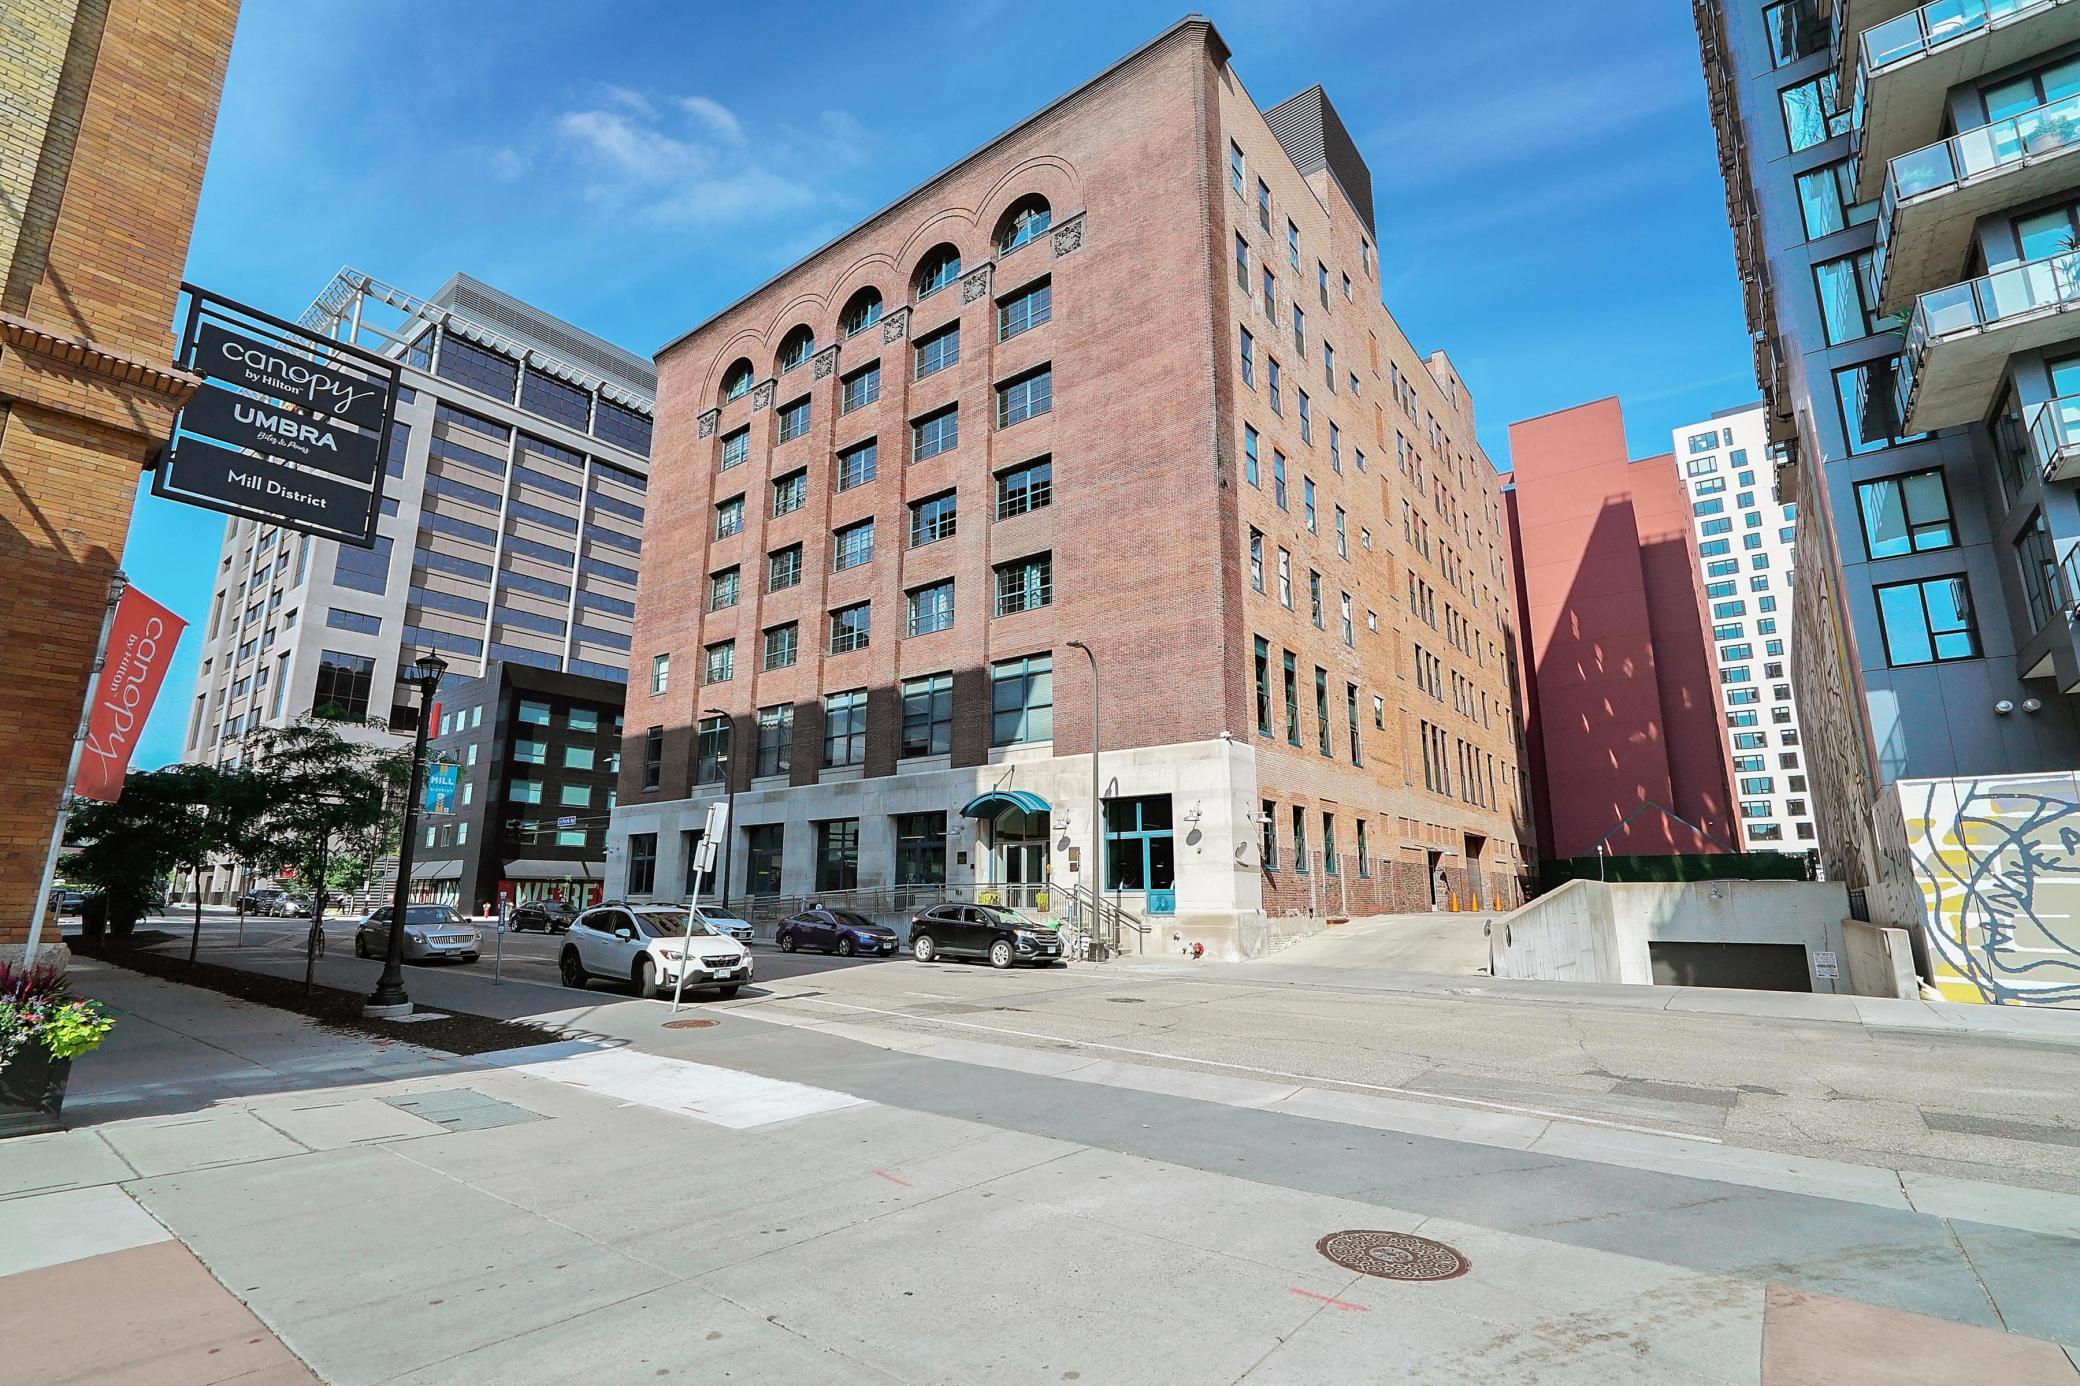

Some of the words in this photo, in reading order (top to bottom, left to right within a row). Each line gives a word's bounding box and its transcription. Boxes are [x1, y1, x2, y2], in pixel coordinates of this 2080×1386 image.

[221, 342, 375, 414] canopy
[245, 369, 260, 382] by
[262, 375, 301, 395] Hilton
[233, 403, 338, 452] UMBRA
[227, 469, 262, 491] Mill
[266, 480, 327, 508] District
[125, 633, 138, 650] by
[110, 650, 134, 692] Hilton
[84, 616, 163, 786] canopy
[431, 776, 454, 786] MILL
